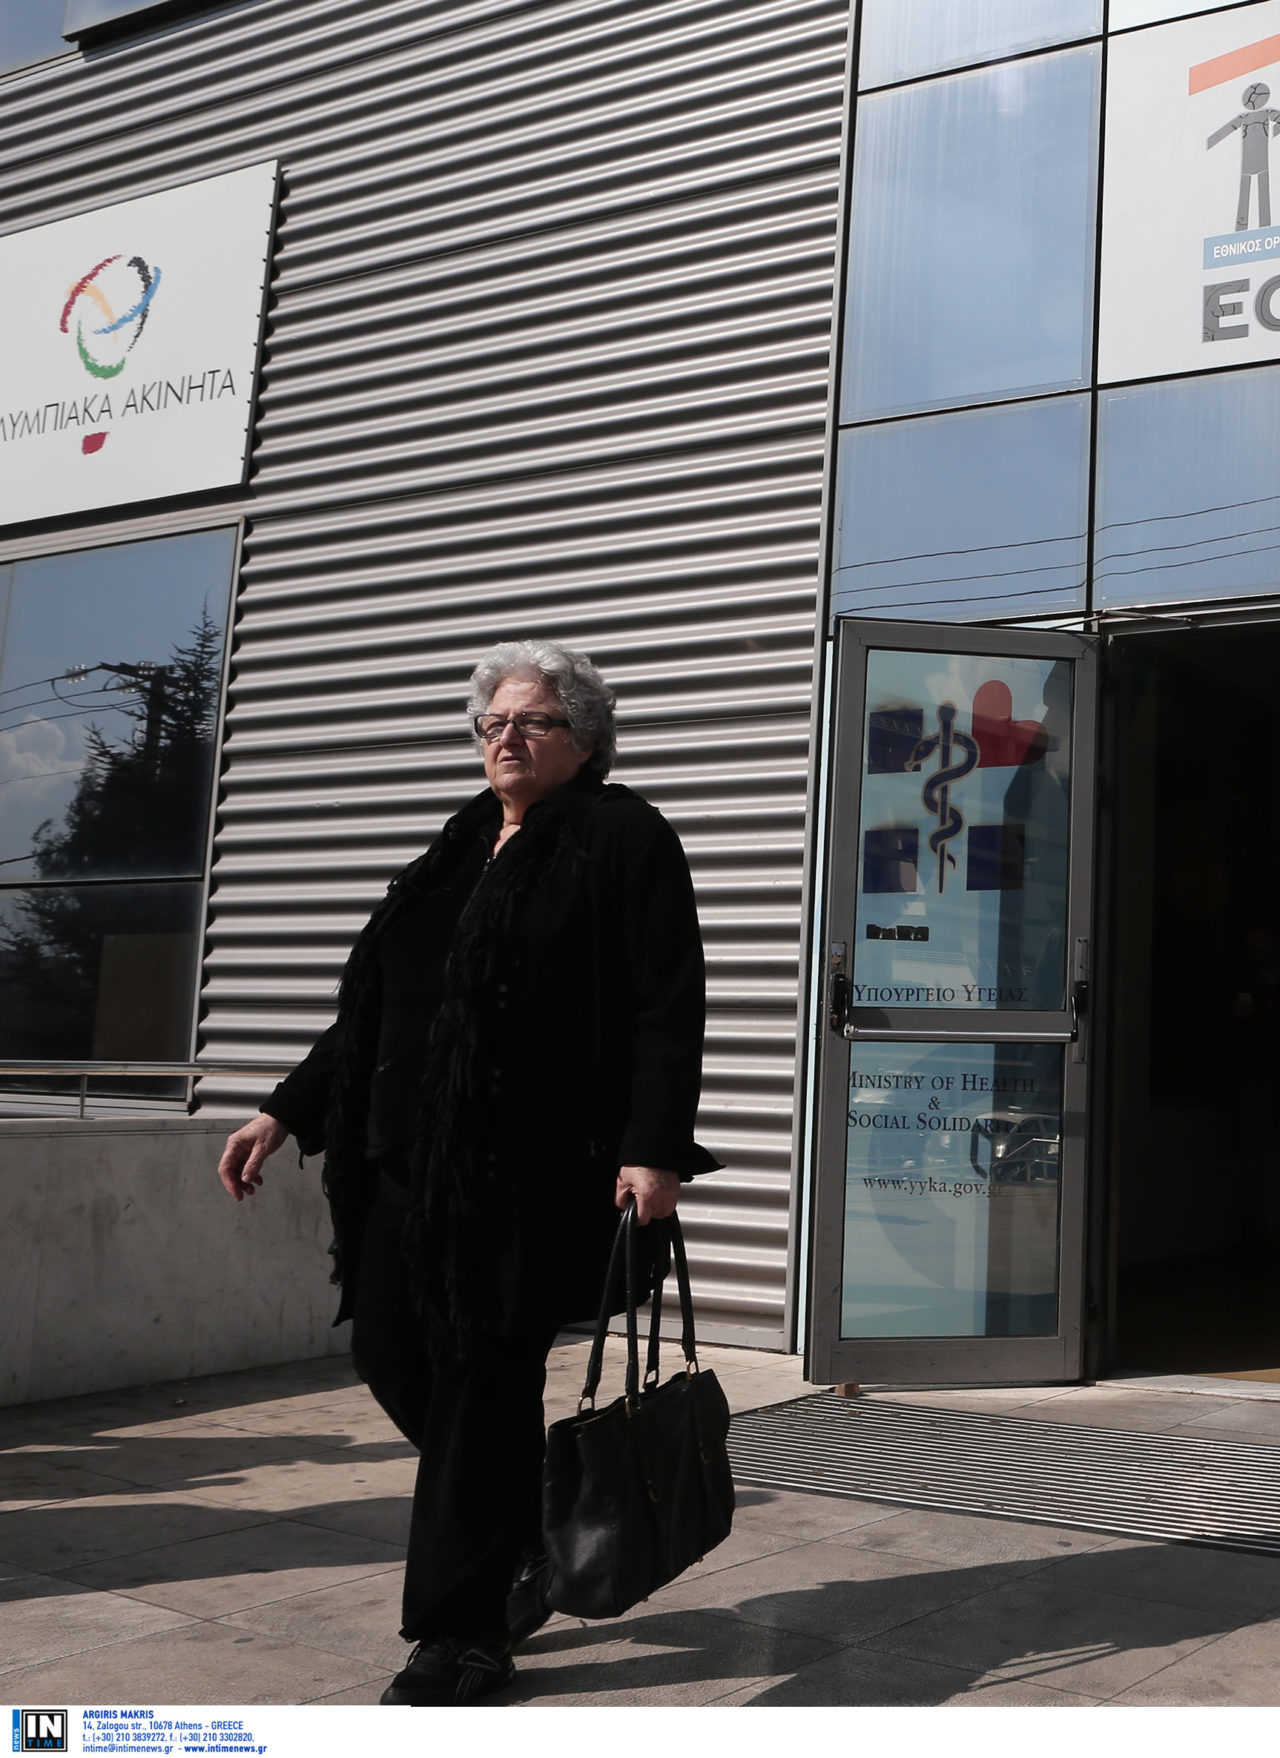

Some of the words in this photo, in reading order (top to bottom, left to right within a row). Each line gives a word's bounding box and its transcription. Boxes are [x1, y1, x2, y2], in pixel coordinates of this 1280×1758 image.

[1213, 237, 1262, 259] ΕΘΝΙΚΟΣ
[121, 367, 236, 418] ΑΚΙΝΗΤΑ
[853, 984, 956, 1002] ΥΠΟΥΡΓΕΙΟ
[962, 984, 1028, 1003] ΥΓΕΙΑΣ
[931, 1076, 955, 1092] OF
[927, 1096, 942, 1111] &
[847, 1109, 911, 1130] SOCIAL
